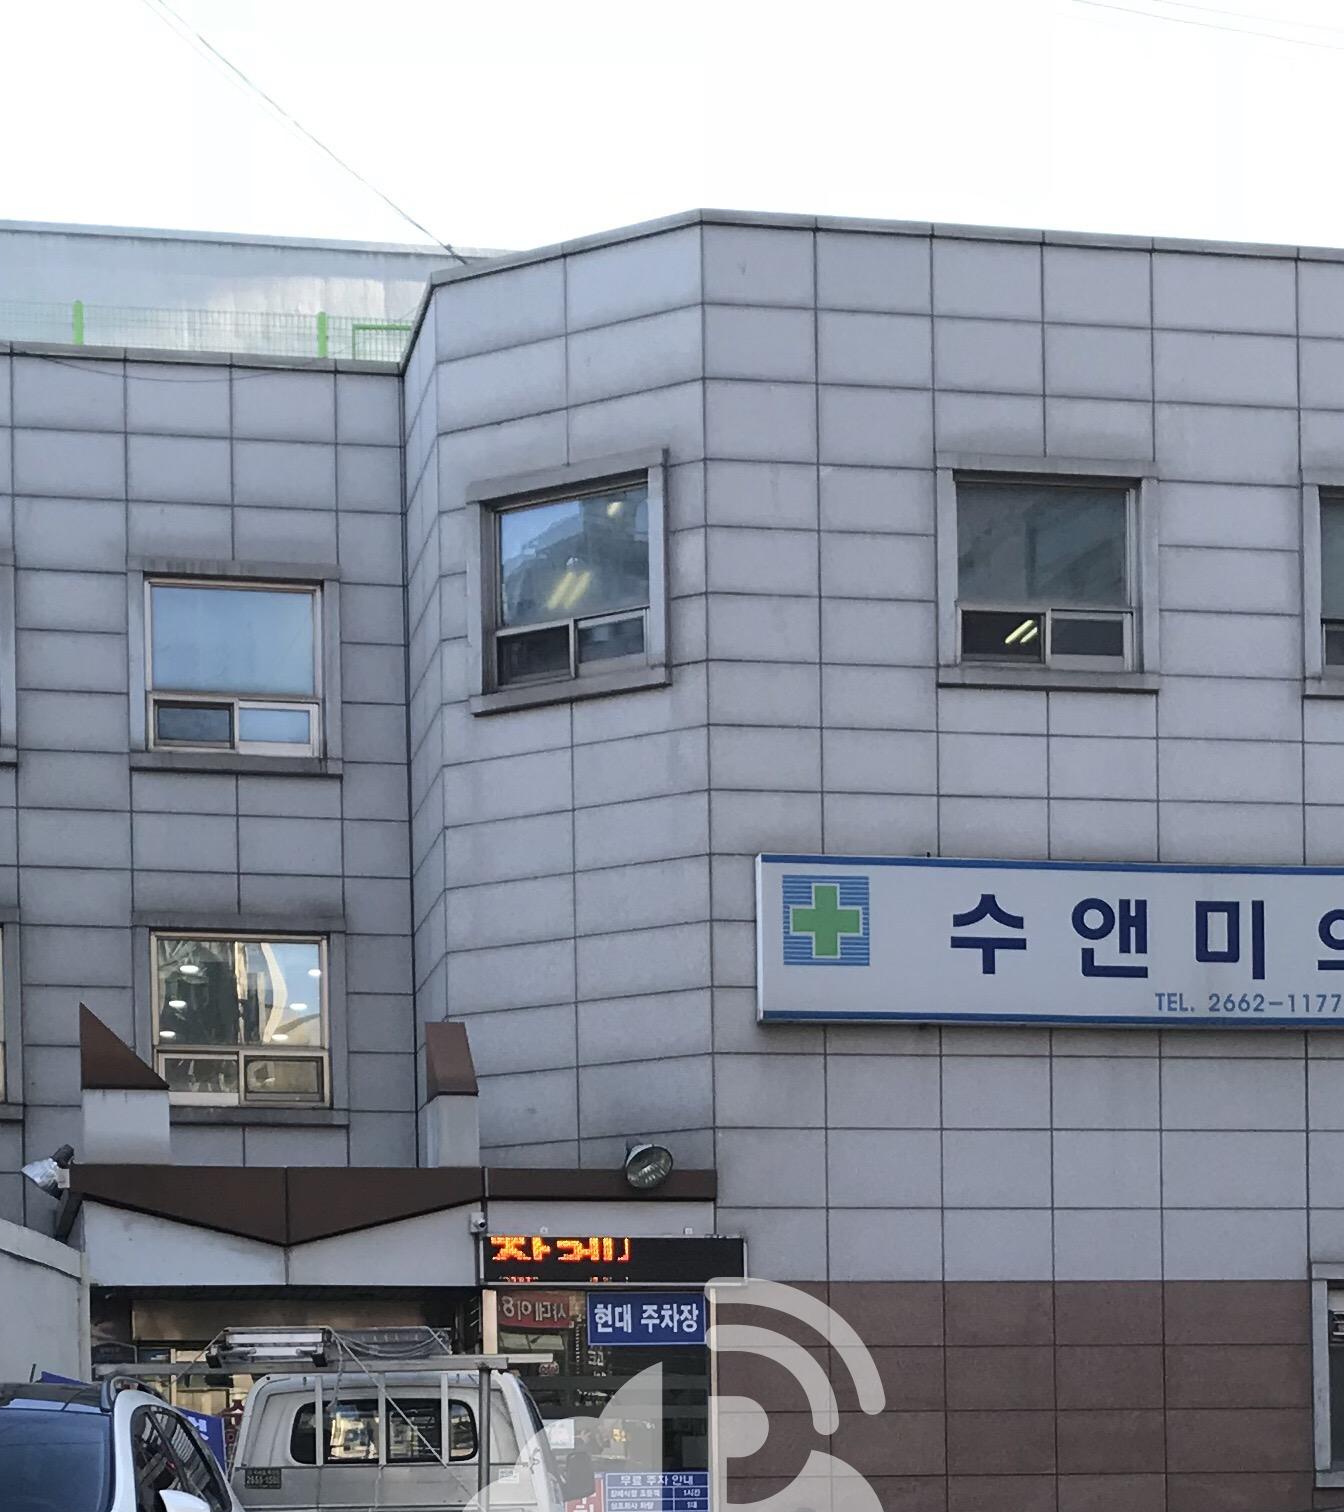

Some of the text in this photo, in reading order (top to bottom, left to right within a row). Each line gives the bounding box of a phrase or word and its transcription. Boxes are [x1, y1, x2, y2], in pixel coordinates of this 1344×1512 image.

[1154, 992, 1196, 1014] TEL.
[1208, 993, 1343, 1014] 2662-1177
[594, 1303, 699, 1333] 현대 주차장
[621, 1475, 642, 1486] 무료
[672, 1475, 694, 1486] 안내
